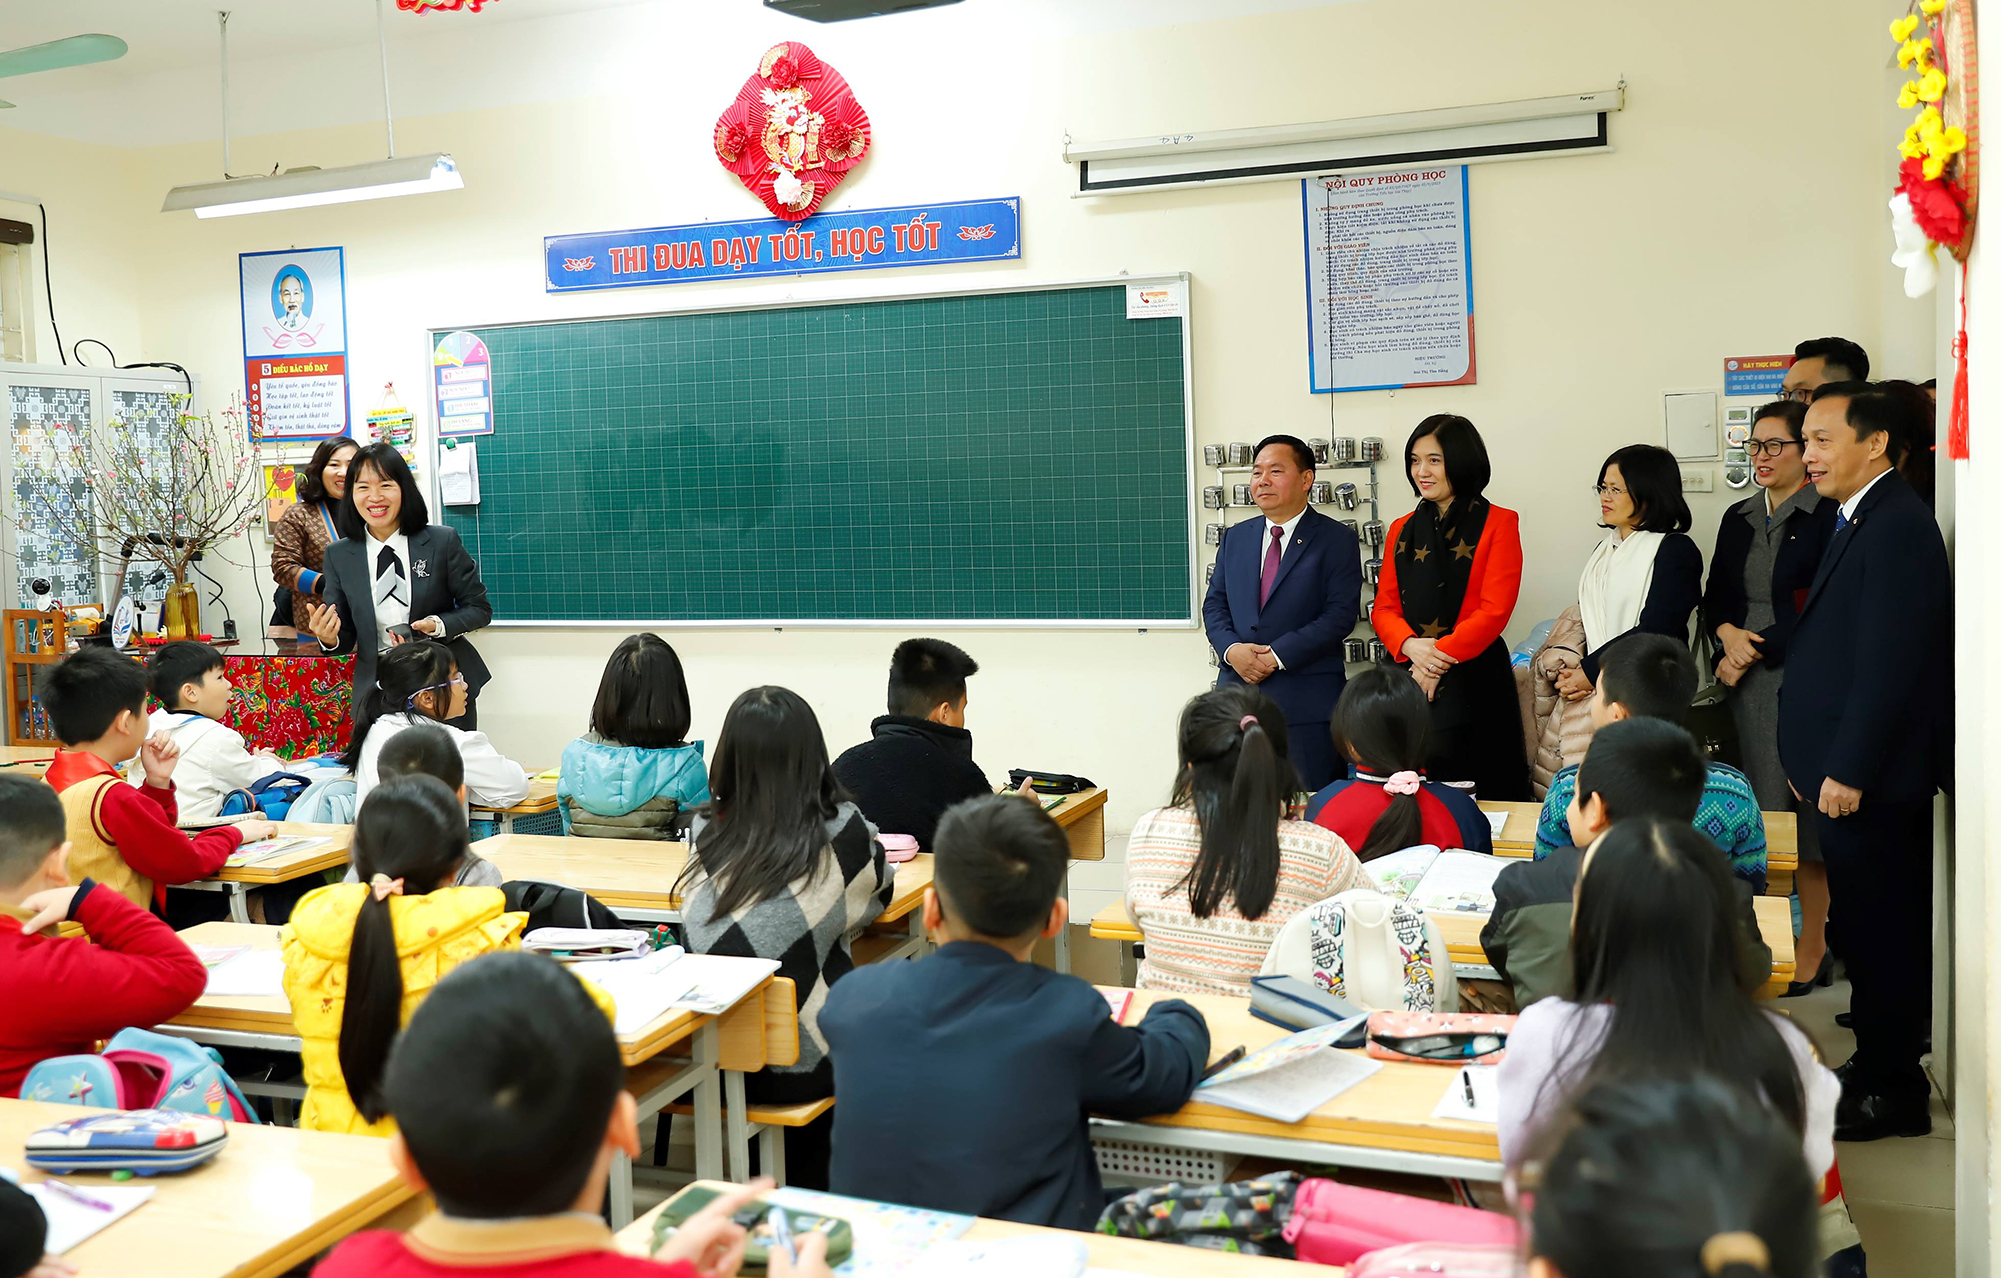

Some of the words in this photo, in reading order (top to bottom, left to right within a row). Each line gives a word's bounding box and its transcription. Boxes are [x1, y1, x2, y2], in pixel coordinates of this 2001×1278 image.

[1325, 178, 1346, 190] NỘI
[1349, 177, 1374, 187] QUY
[1377, 171, 1417, 184] PHÒNG
[1422, 170, 1446, 181] HỌC
[608, 247, 647, 274] THI
[652, 241, 704, 272] ĐUA
[712, 236, 762, 272] DẠY
[768, 222, 822, 264] TỐT,
[830, 225, 885, 264] HỌC
[892, 211, 942, 253] TỐT
[466, 336, 471, 344] 2
[478, 348, 484, 356] 3
[263, 365, 270, 374] 5
[289, 363, 303, 373] BÁC
[304, 362, 314, 372] HỒ
[314, 364, 329, 373] DẠY
